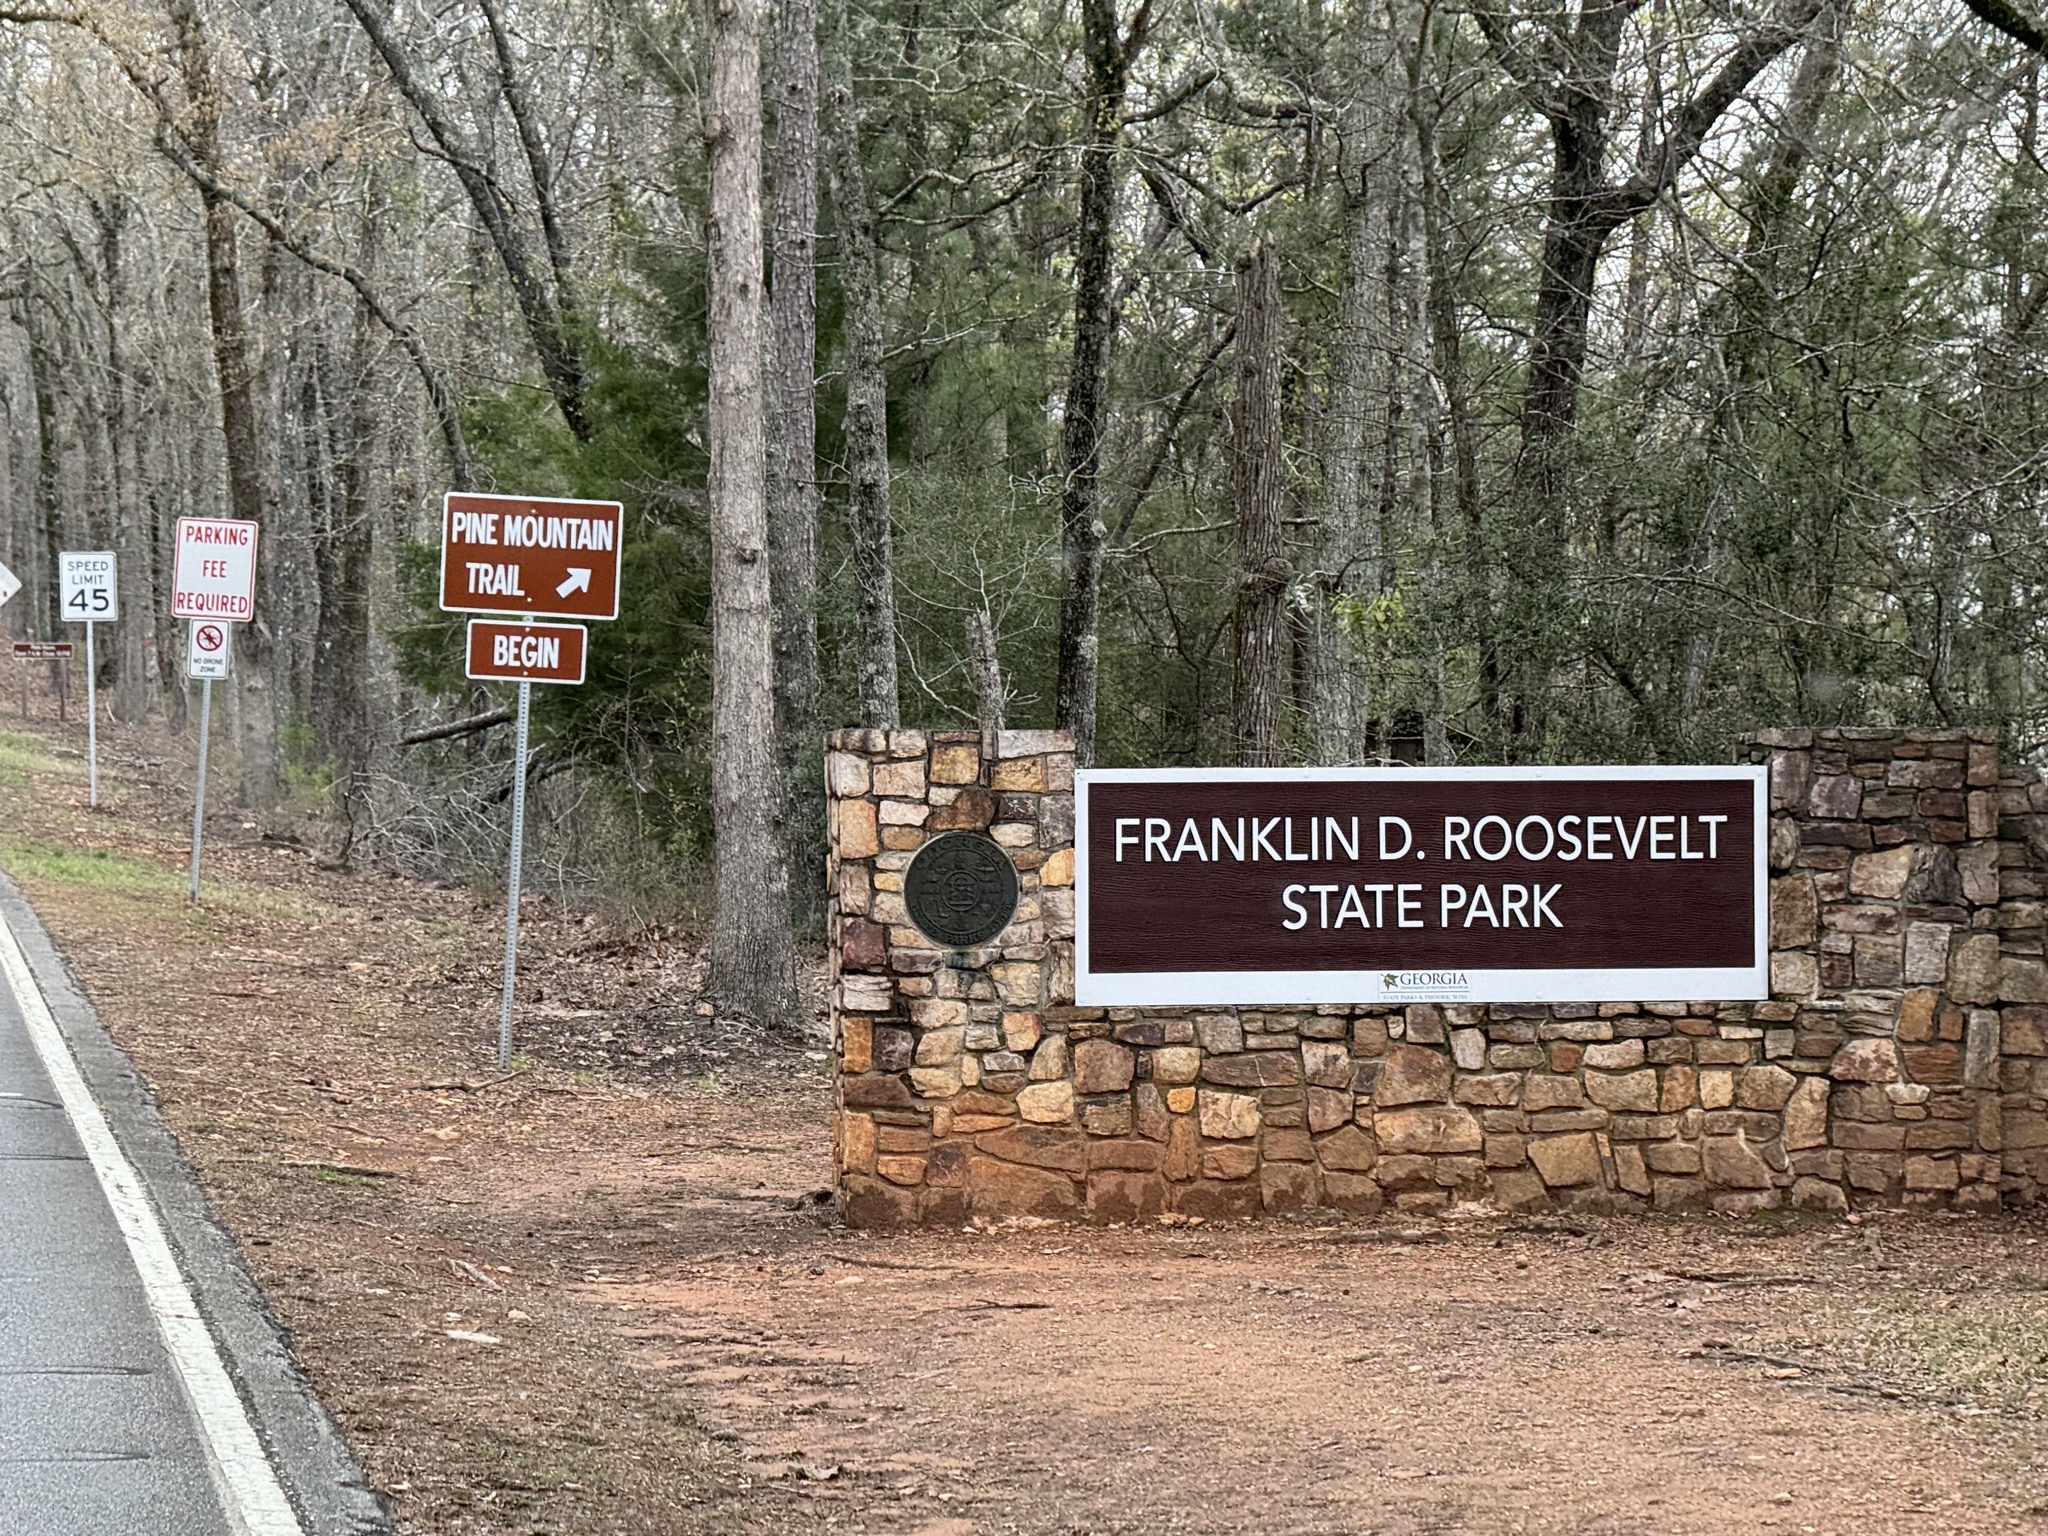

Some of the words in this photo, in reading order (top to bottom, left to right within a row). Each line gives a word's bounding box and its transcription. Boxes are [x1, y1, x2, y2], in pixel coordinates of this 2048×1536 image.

[186, 525, 248, 546] PARKING
[451, 511, 499, 545] PINE
[503, 514, 613, 551] MOUNTAIN
[67, 561, 109, 571] SPEED
[202, 560, 227, 578] FEE
[72, 575, 104, 585] LIMIT
[465, 562, 525, 596] TRAIL
[68, 588, 109, 612] 45
[177, 592, 248, 613] REQUIRED
[493, 634, 560, 669] BEGIN
[1115, 816, 1359, 862] FRANKLIN
[1378, 816, 1426, 861] D.
[1444, 815, 1728, 861] ROOSEVELT
[1282, 883, 1424, 930] STATE
[1440, 883, 1564, 928] PARK
[1400, 972, 1468, 985] GEORGIA
